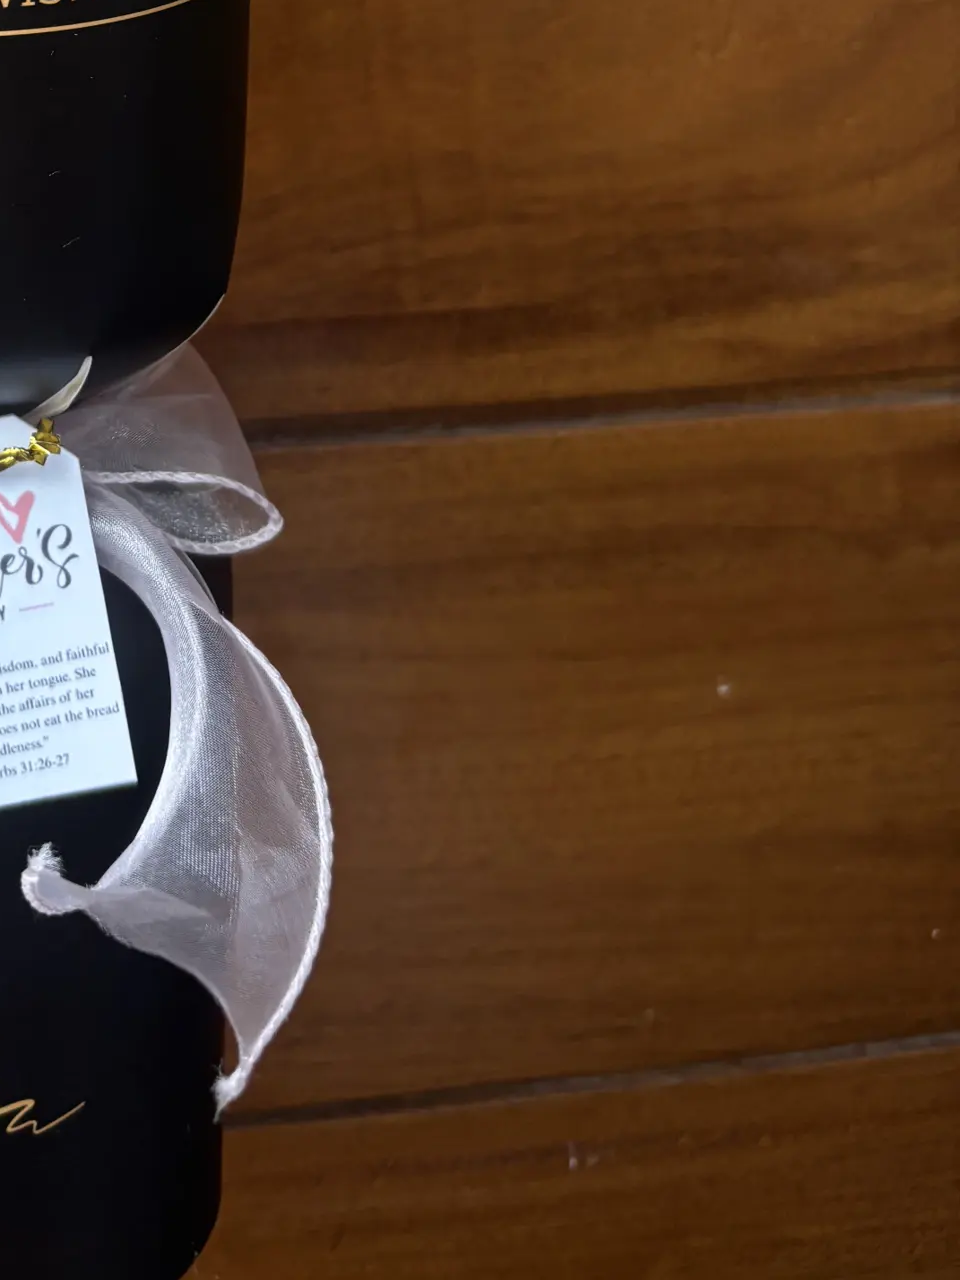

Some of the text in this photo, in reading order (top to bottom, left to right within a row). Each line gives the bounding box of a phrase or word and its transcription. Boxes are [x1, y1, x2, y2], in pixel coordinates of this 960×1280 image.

[40, 650, 64, 667] and
[66, 641, 111, 663] faithful
[5, 681, 26, 695] her
[28, 672, 72, 690] tongue.
[74, 666, 97, 681] She
[19, 694, 57, 713] affairs
[59, 689, 73, 704] of
[75, 687, 95, 701] her
[21, 717, 41, 733] not
[44, 714, 62, 728] eat
[64, 709, 84, 724] the
[86, 700, 121, 719] bread
[20, 752, 70, 775] 31:26-27
